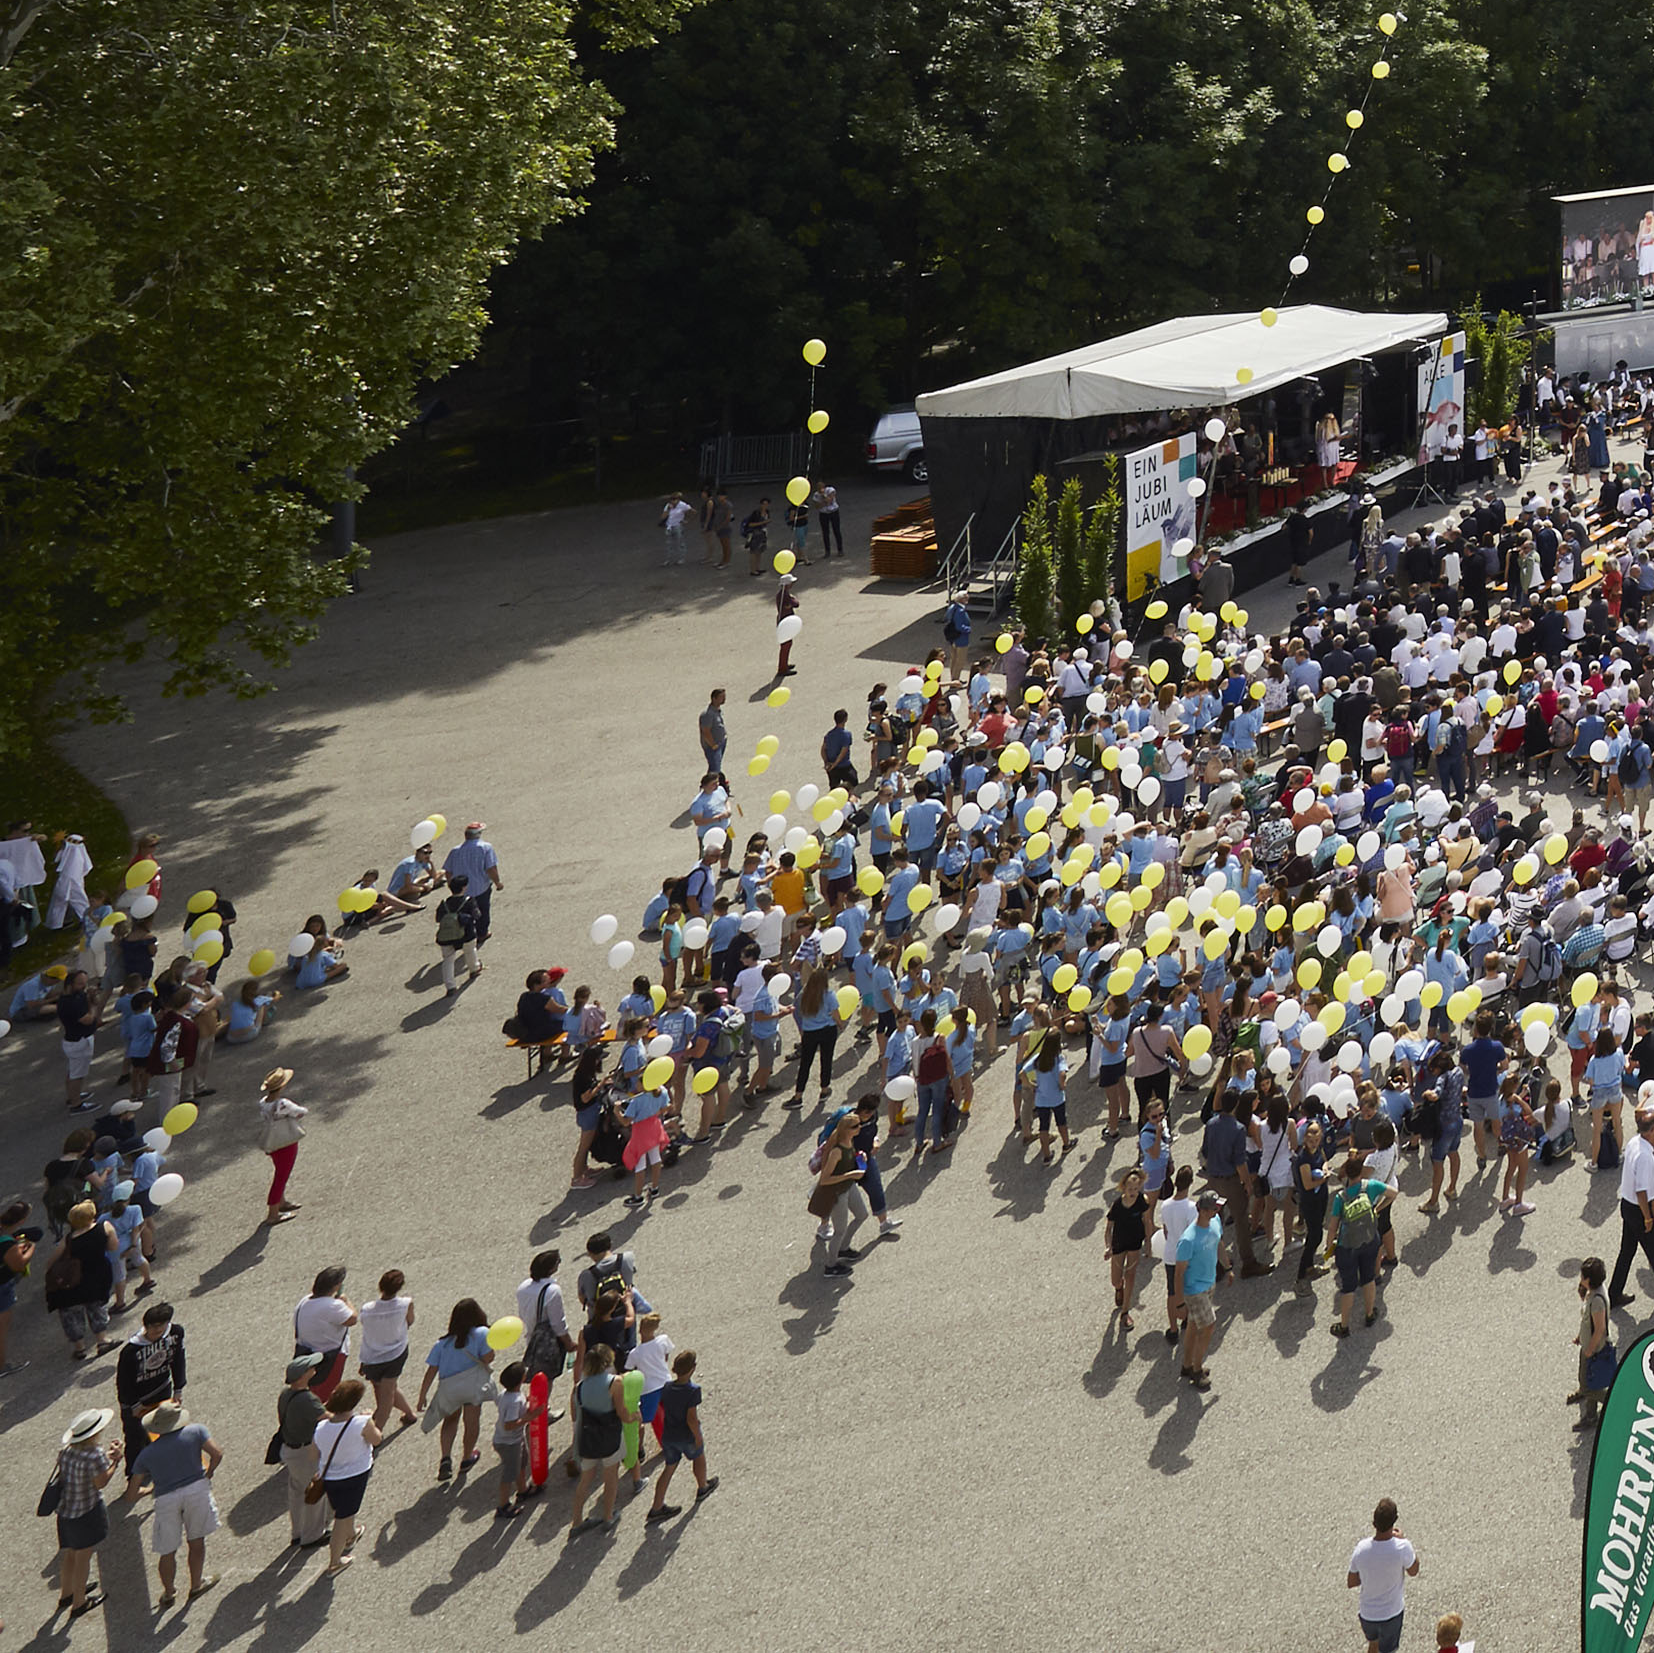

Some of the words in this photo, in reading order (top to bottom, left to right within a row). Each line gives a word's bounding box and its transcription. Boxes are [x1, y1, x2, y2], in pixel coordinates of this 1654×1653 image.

[1134, 454, 1157, 479] EIN
[1134, 475, 1167, 504] JUBI
[1135, 497, 1172, 529] LÄUM
[1623, 1600, 1641, 1638] Das
